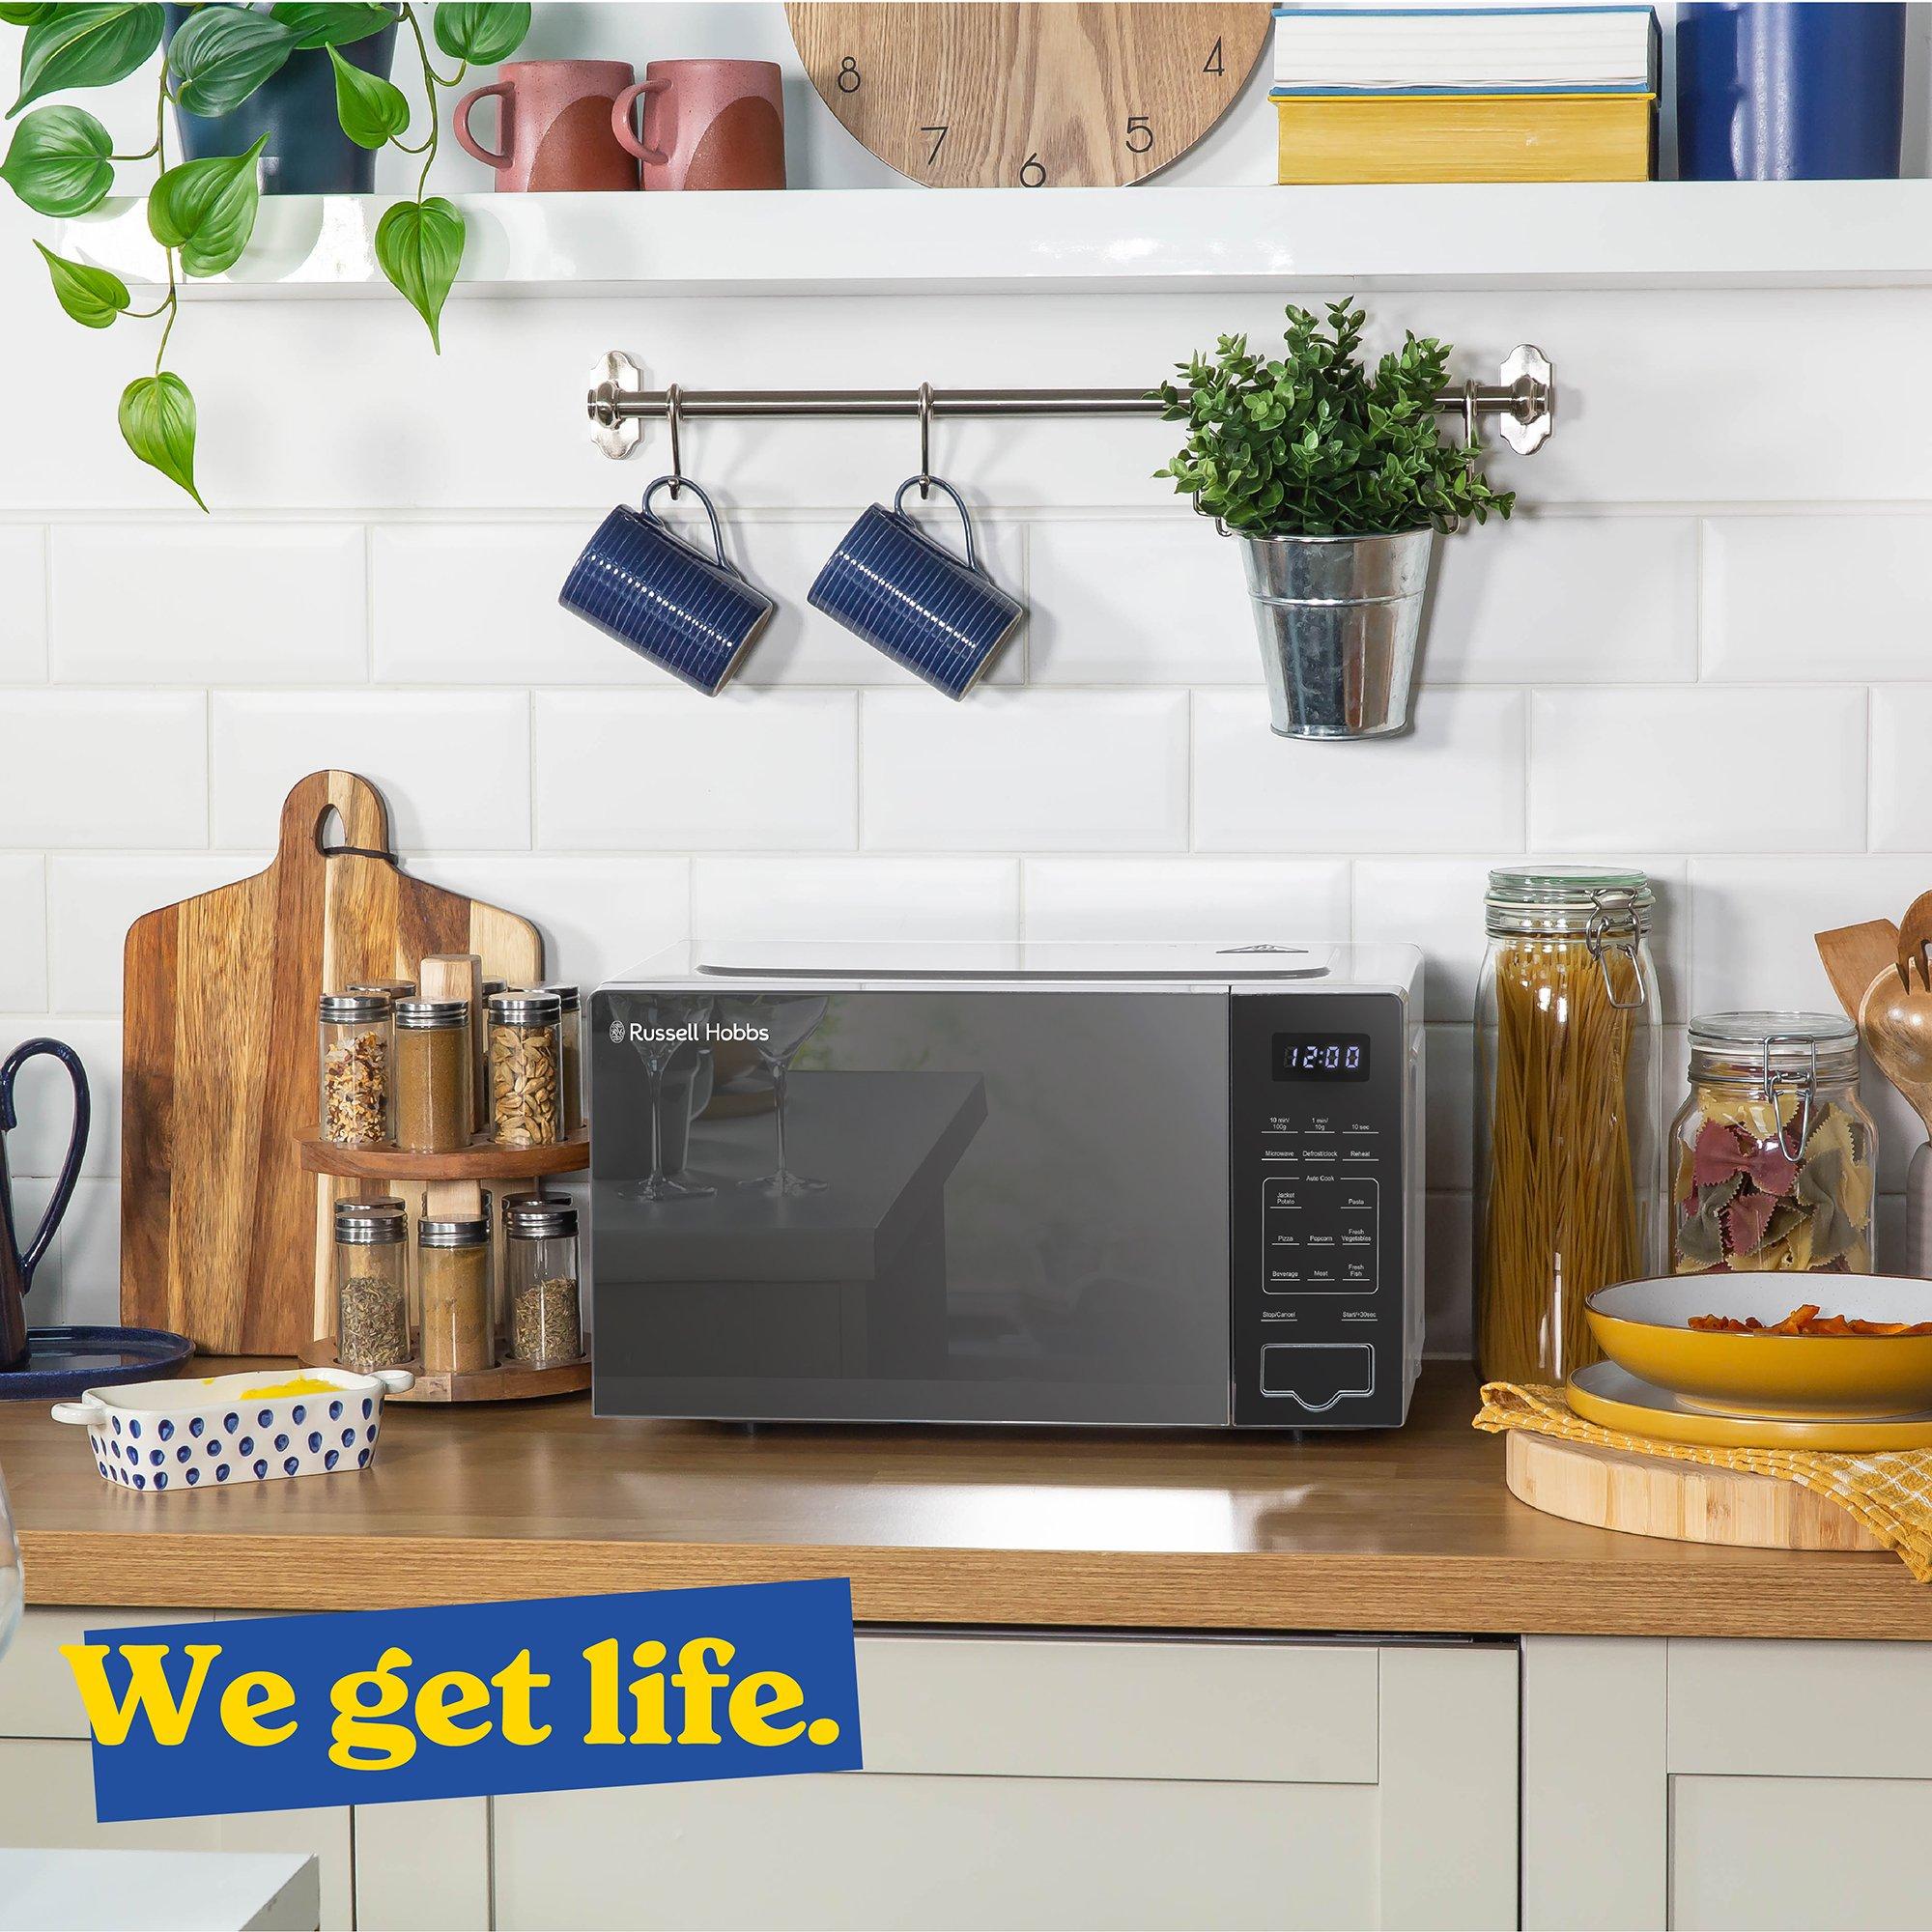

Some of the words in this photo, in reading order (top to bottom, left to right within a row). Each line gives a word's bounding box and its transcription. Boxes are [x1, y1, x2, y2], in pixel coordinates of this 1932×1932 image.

[838, 56, 862, 94] 8
[1203, 36, 1225, 76] 4
[921, 126, 949, 165] 7
[1125, 116, 1153, 154] 5
[1019, 153, 1047, 188] 6
[630, 1023, 699, 1041] Russell
[706, 1023, 770, 1041] Hobbs
[1292, 1046, 1360, 1068] 12:00
